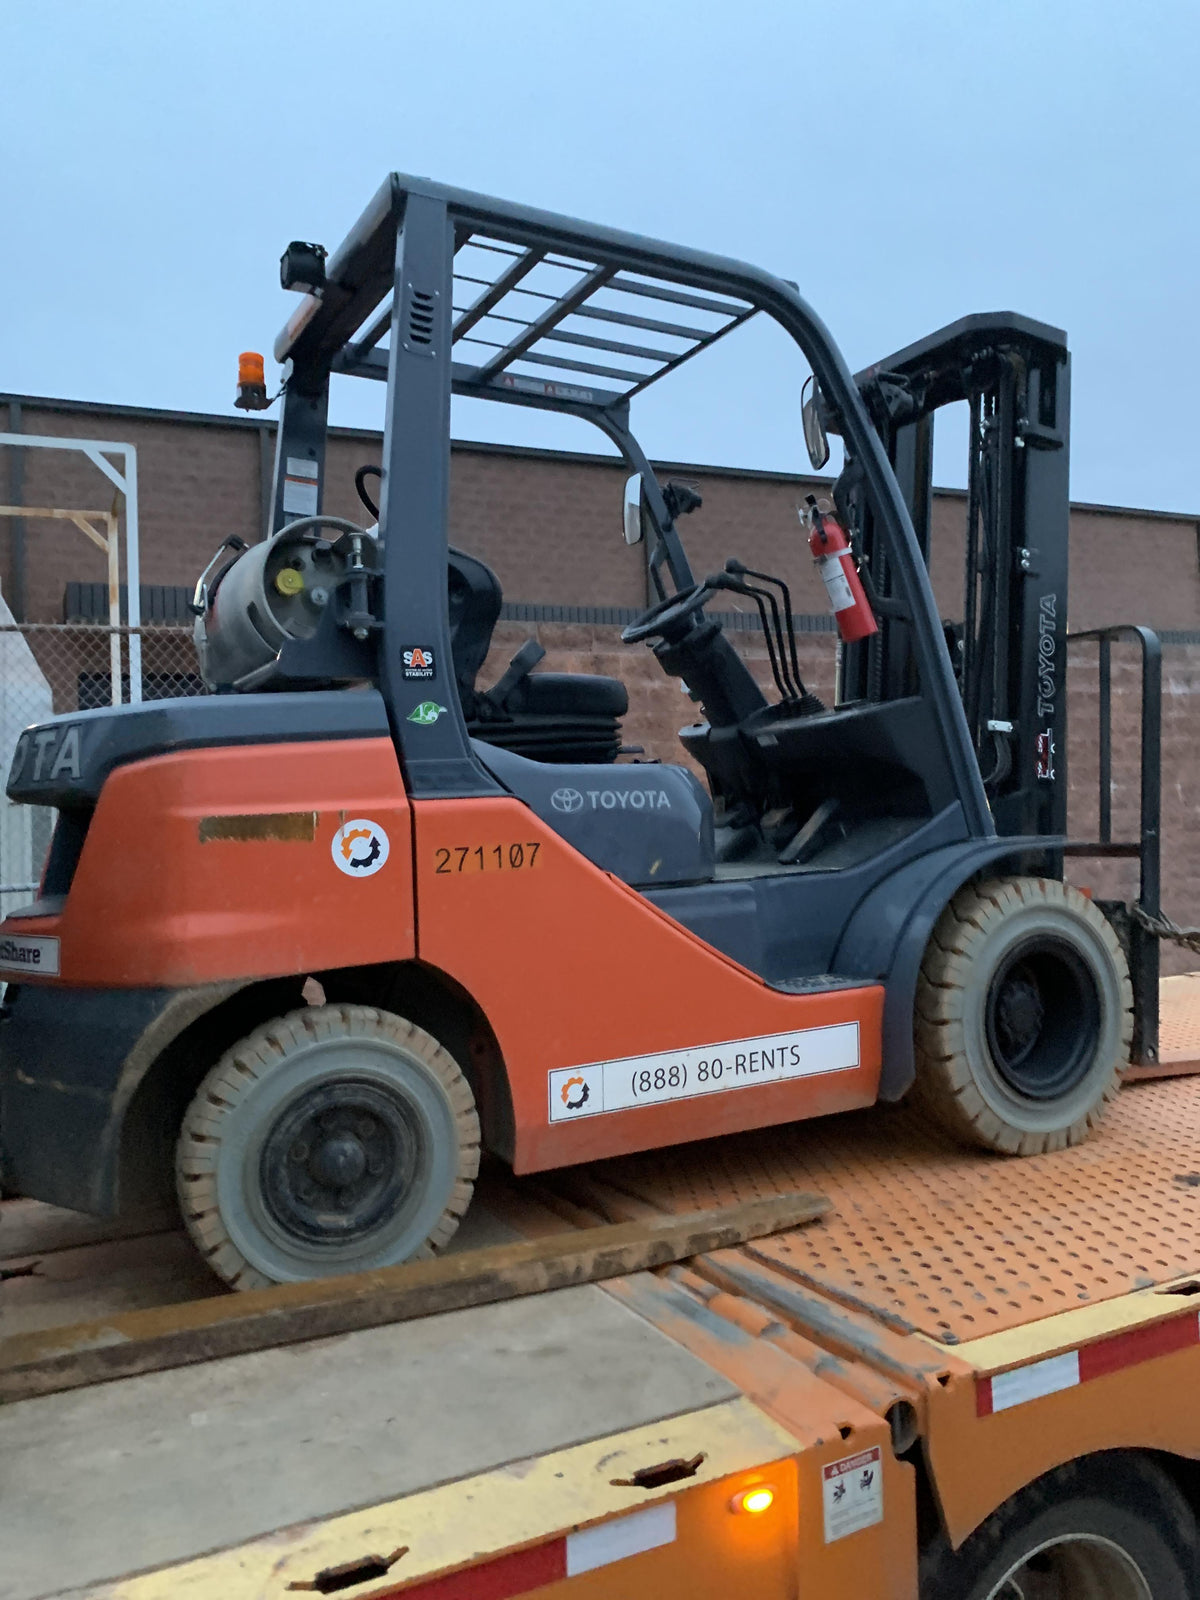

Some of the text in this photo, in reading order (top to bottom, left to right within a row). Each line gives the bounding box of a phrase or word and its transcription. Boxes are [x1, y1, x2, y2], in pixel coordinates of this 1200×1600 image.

[403, 648, 433, 668] SAS
[1037, 593, 1057, 718] TOYOTA
[586, 790, 671, 810] TOYOTA
[435, 842, 541, 874] 271107
[631, 1044, 801, 1097] (888) 80-RENTS
